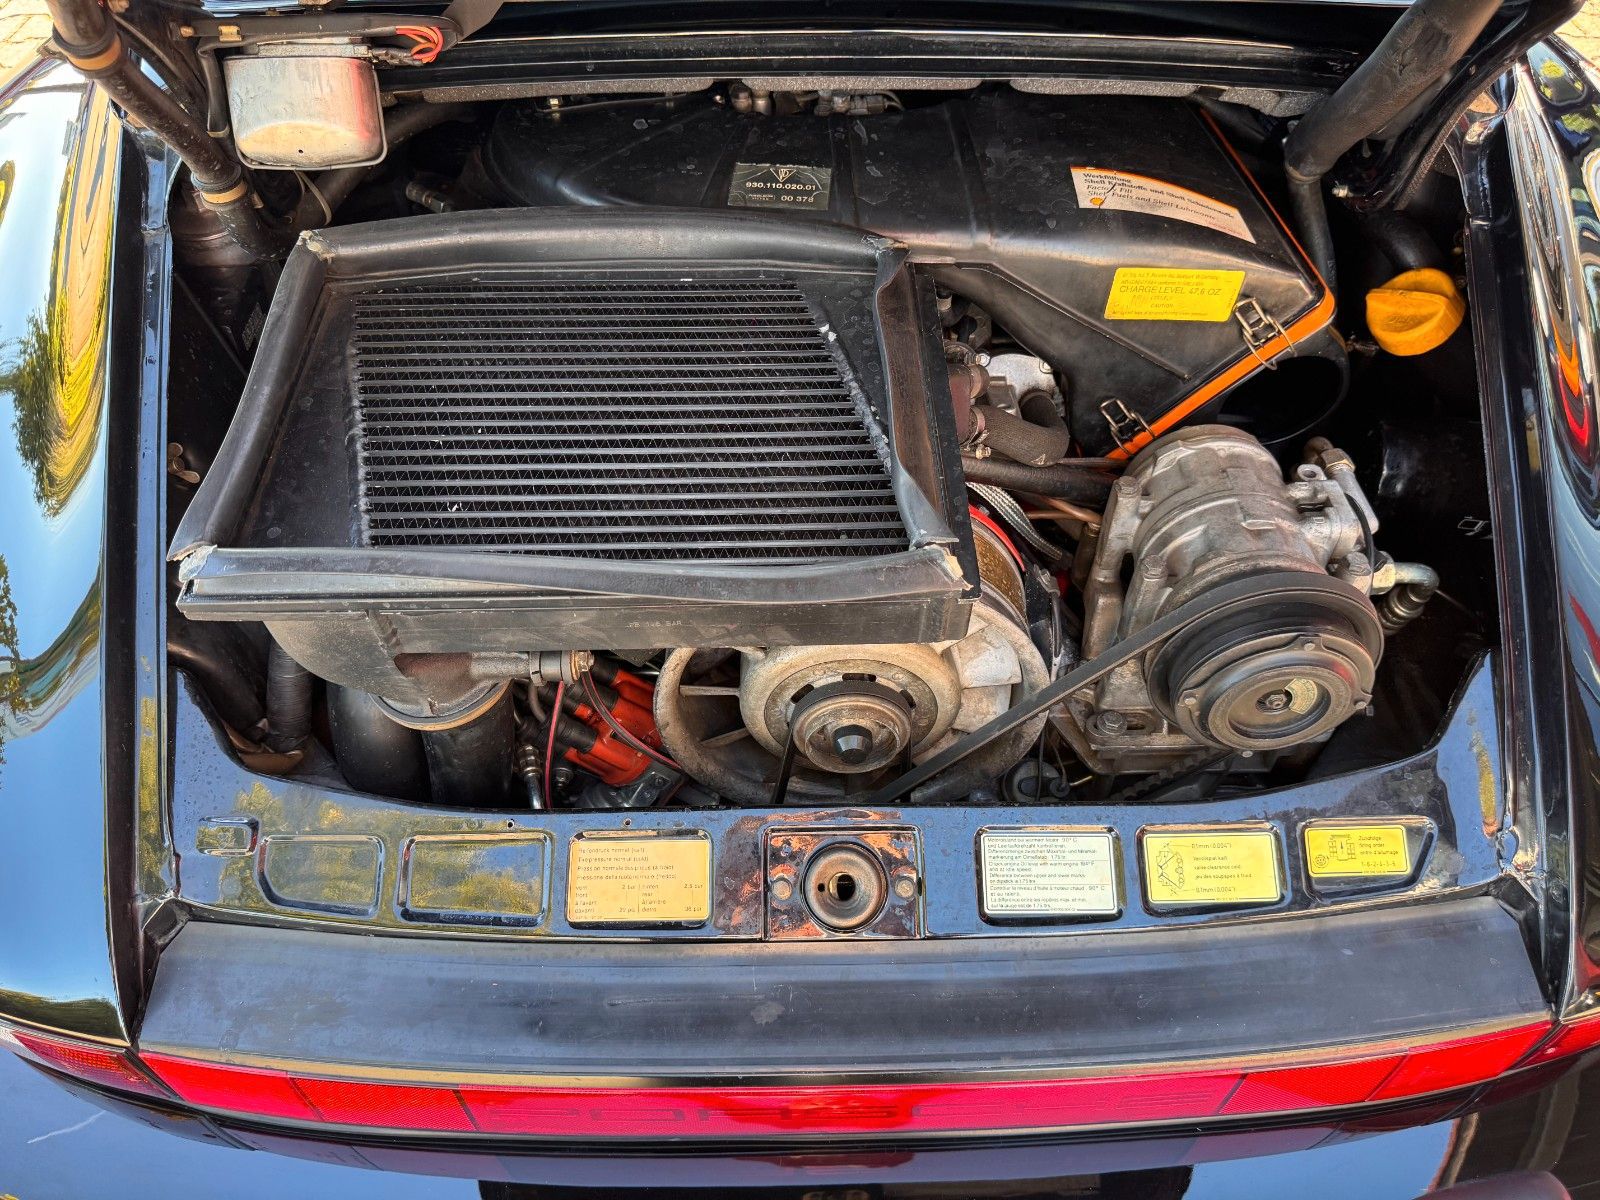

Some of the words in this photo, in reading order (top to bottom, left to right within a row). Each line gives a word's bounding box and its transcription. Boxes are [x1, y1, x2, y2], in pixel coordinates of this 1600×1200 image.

[745, 182, 816, 190] 930.110.020.01
[1153, 198, 1174, 207] Shell
[1158, 286, 1185, 294] LEVEL
[1207, 288, 1222, 296] OZ
